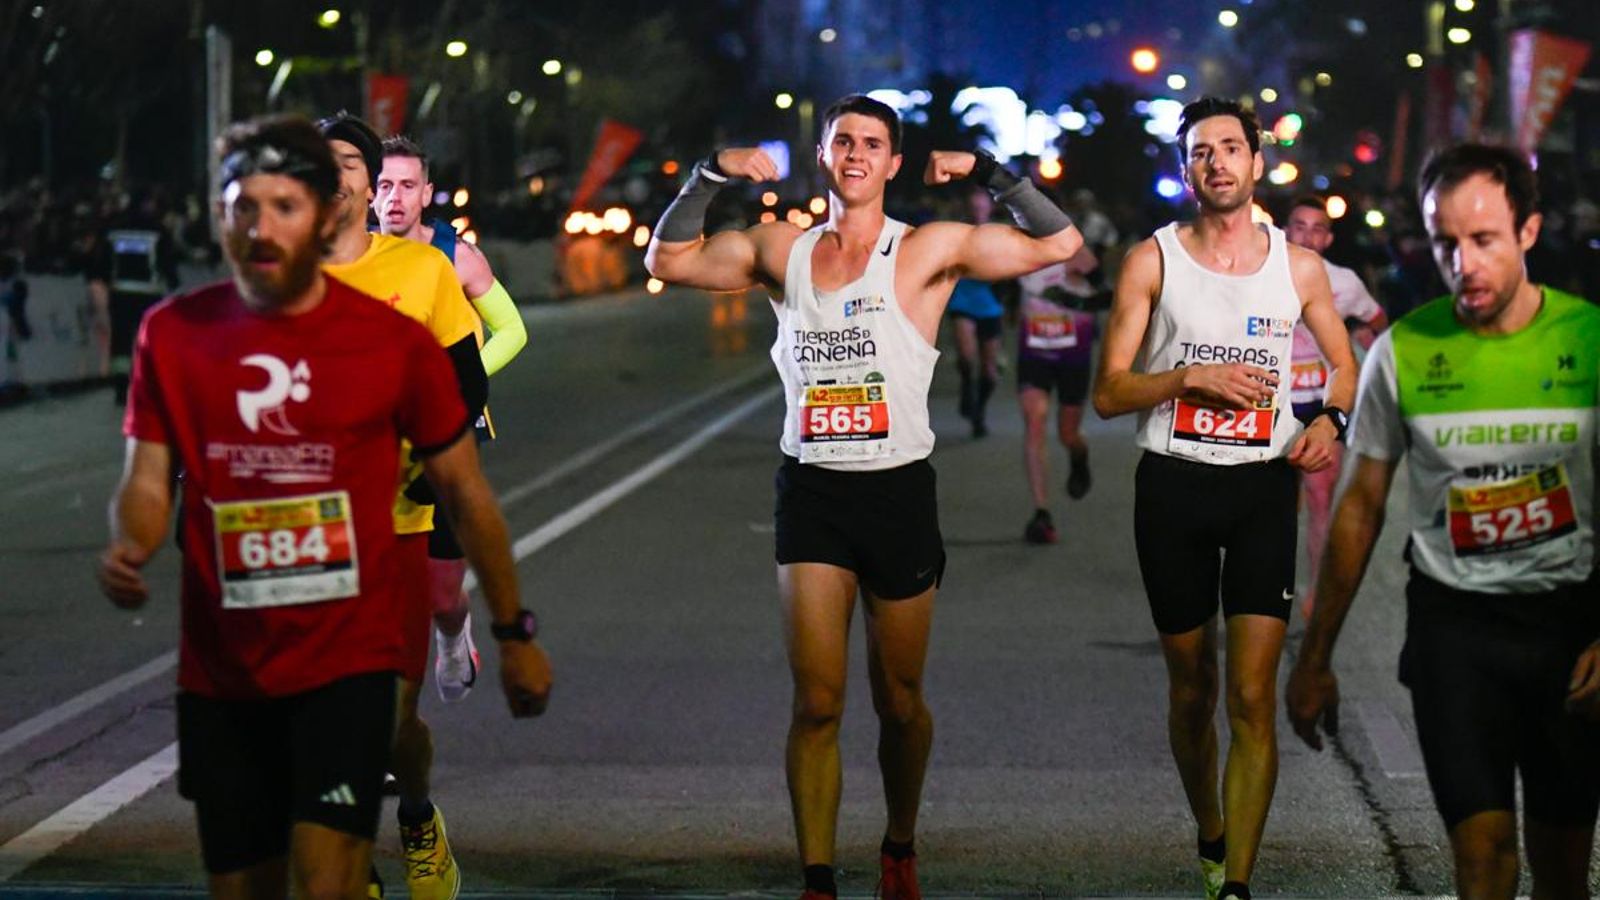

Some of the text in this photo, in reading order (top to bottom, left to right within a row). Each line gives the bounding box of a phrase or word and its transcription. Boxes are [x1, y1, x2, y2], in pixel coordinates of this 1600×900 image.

[809, 405, 873, 434] 565
[1193, 407, 1258, 438] 624
[1471, 497, 1554, 545] 525
[239, 525, 330, 569] 684
